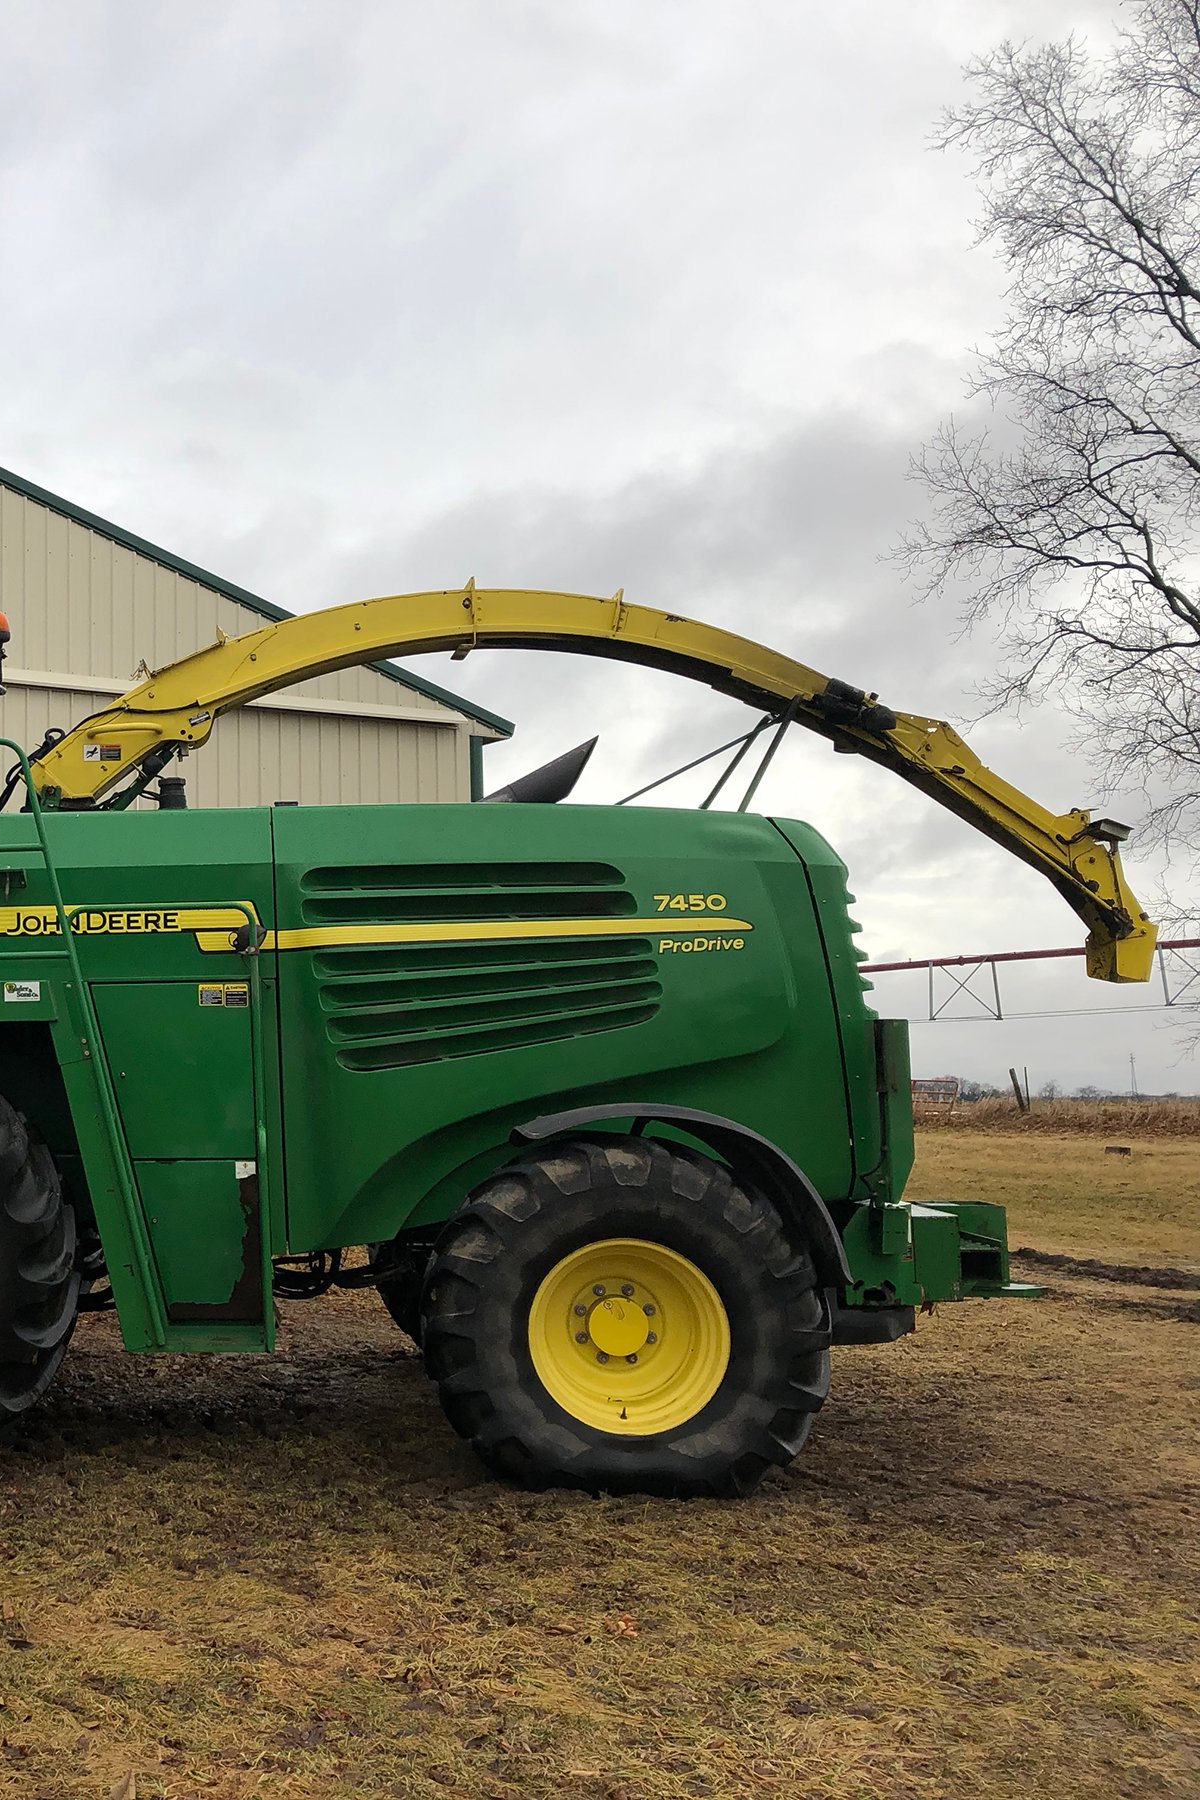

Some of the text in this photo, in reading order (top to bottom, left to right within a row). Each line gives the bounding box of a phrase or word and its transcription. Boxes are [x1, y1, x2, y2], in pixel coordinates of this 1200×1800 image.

[653, 893, 727, 912] 7450
[86, 911, 179, 931] DEERE
[658, 936, 745, 954] ProDrive
